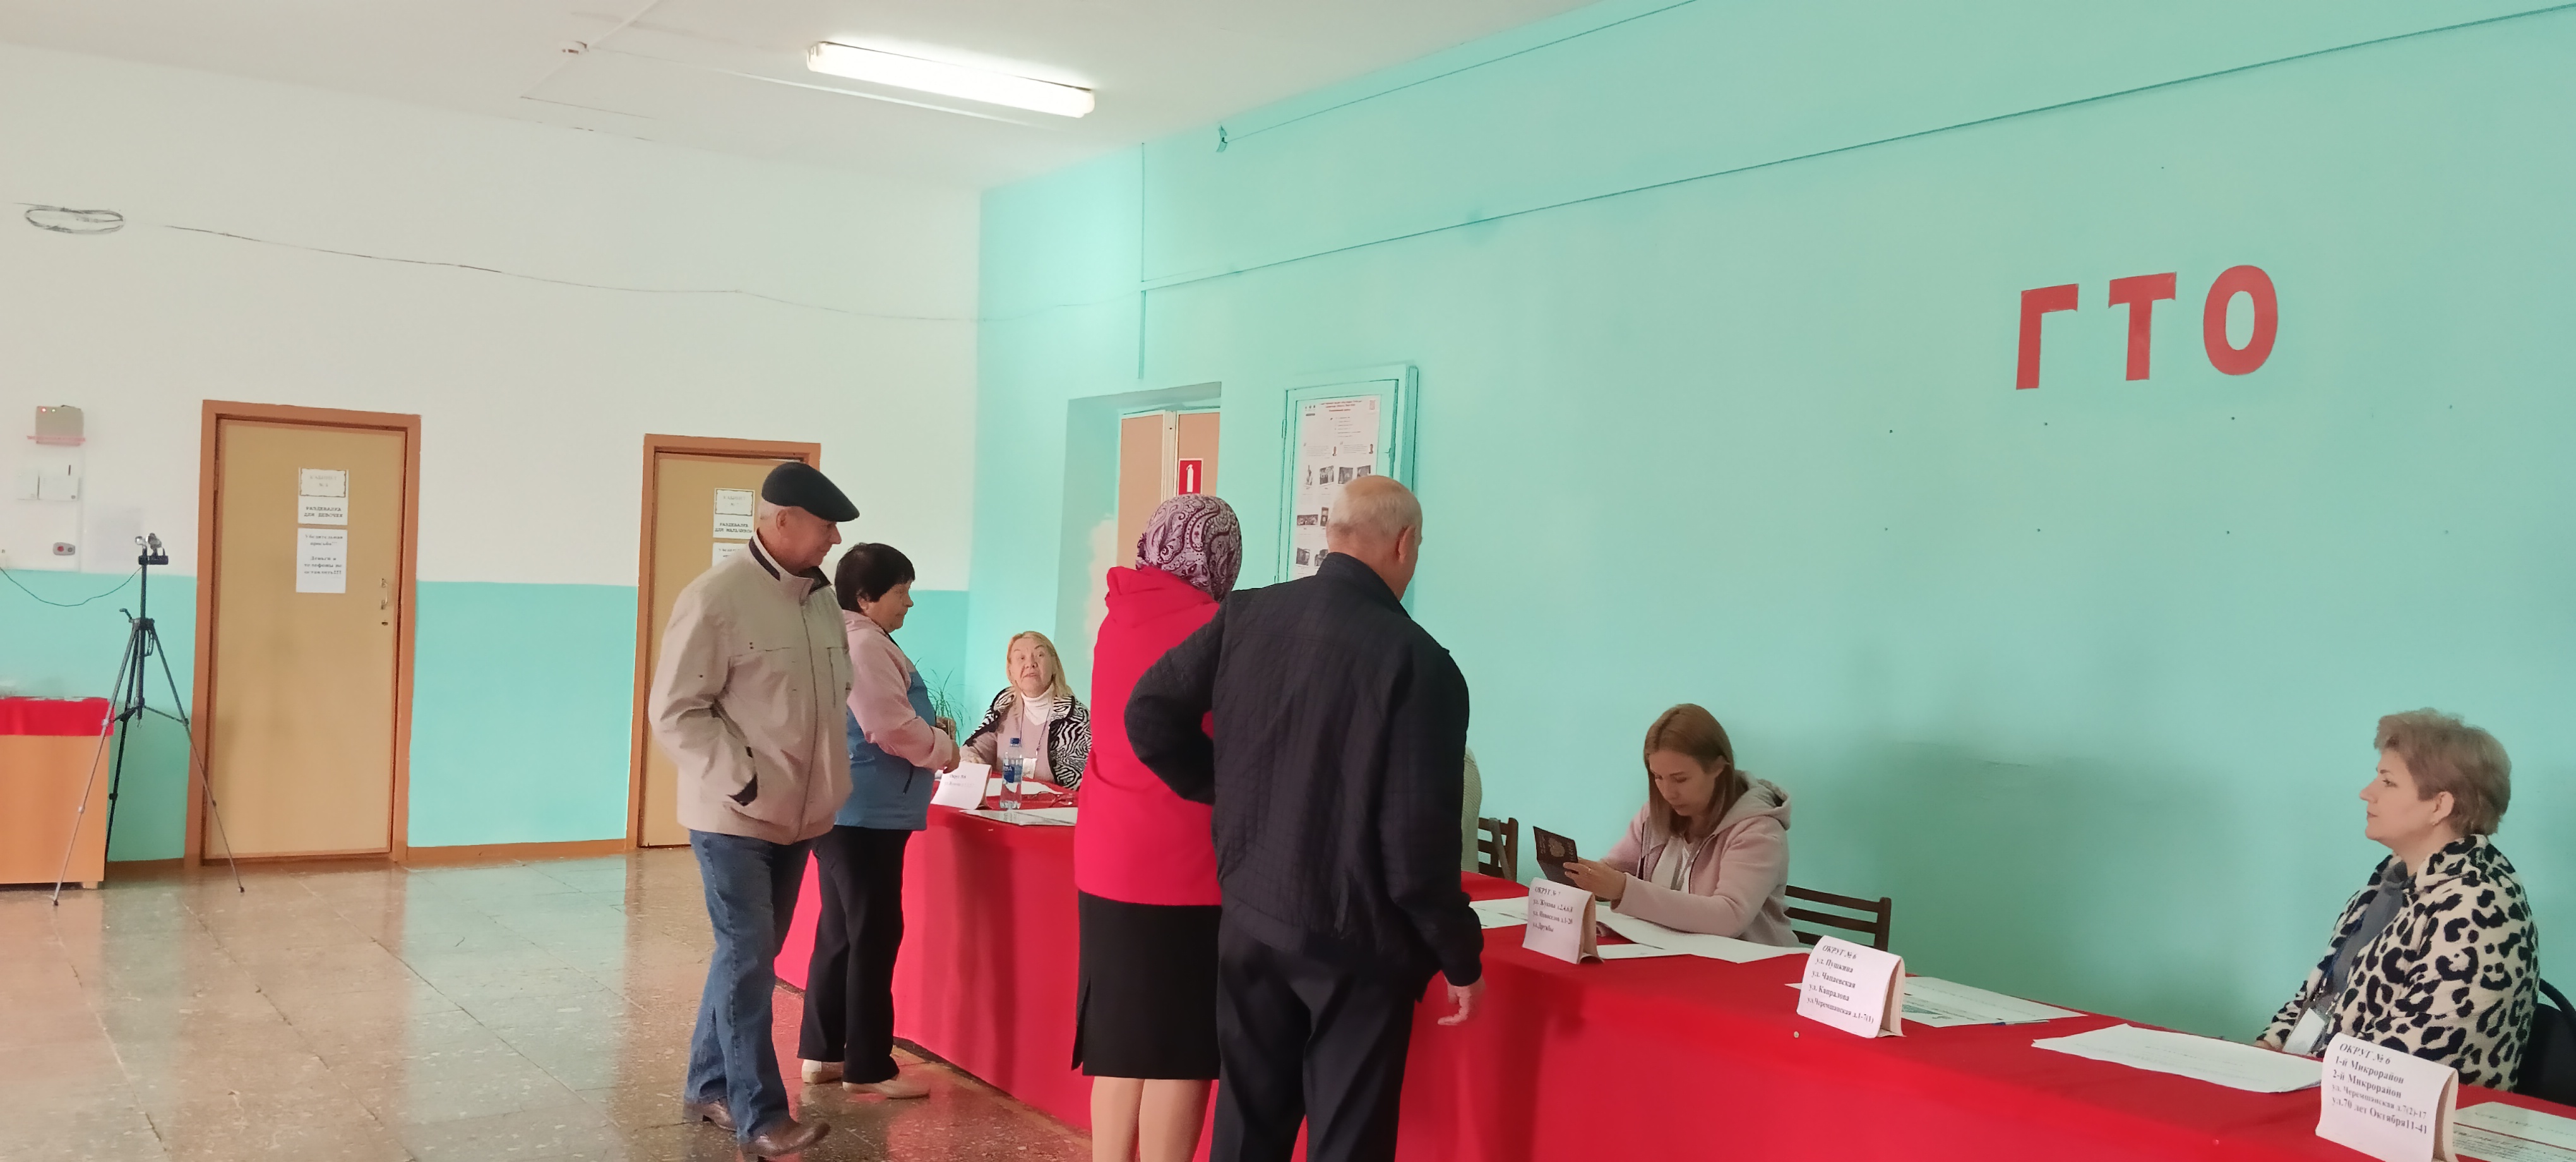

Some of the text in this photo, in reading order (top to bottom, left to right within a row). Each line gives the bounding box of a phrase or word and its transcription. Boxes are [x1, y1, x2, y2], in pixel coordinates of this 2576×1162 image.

[2016, 265, 2278, 390] ГТО
[1822, 945, 1844, 956] ОКРУГ
[1825, 959, 1854, 973] Пушкина
[1811, 970, 1856, 989] ул. Чапаевская
[1808, 983, 1850, 1002] ул. Капралова
[2339, 1043, 2373, 1059] ОКРУГ
[2373, 1053, 2384, 1063] №
[2335, 1055, 2405, 1085] 1-й Микрорайон
[2332, 1069, 2402, 1099] 2-й Микрорайон
[2332, 1084, 2341, 1092] ул.
[2343, 1085, 2395, 1109] Черемшанская
[2332, 1097, 2353, 1109] ул.70
[2354, 1105, 2368, 1115] лет
